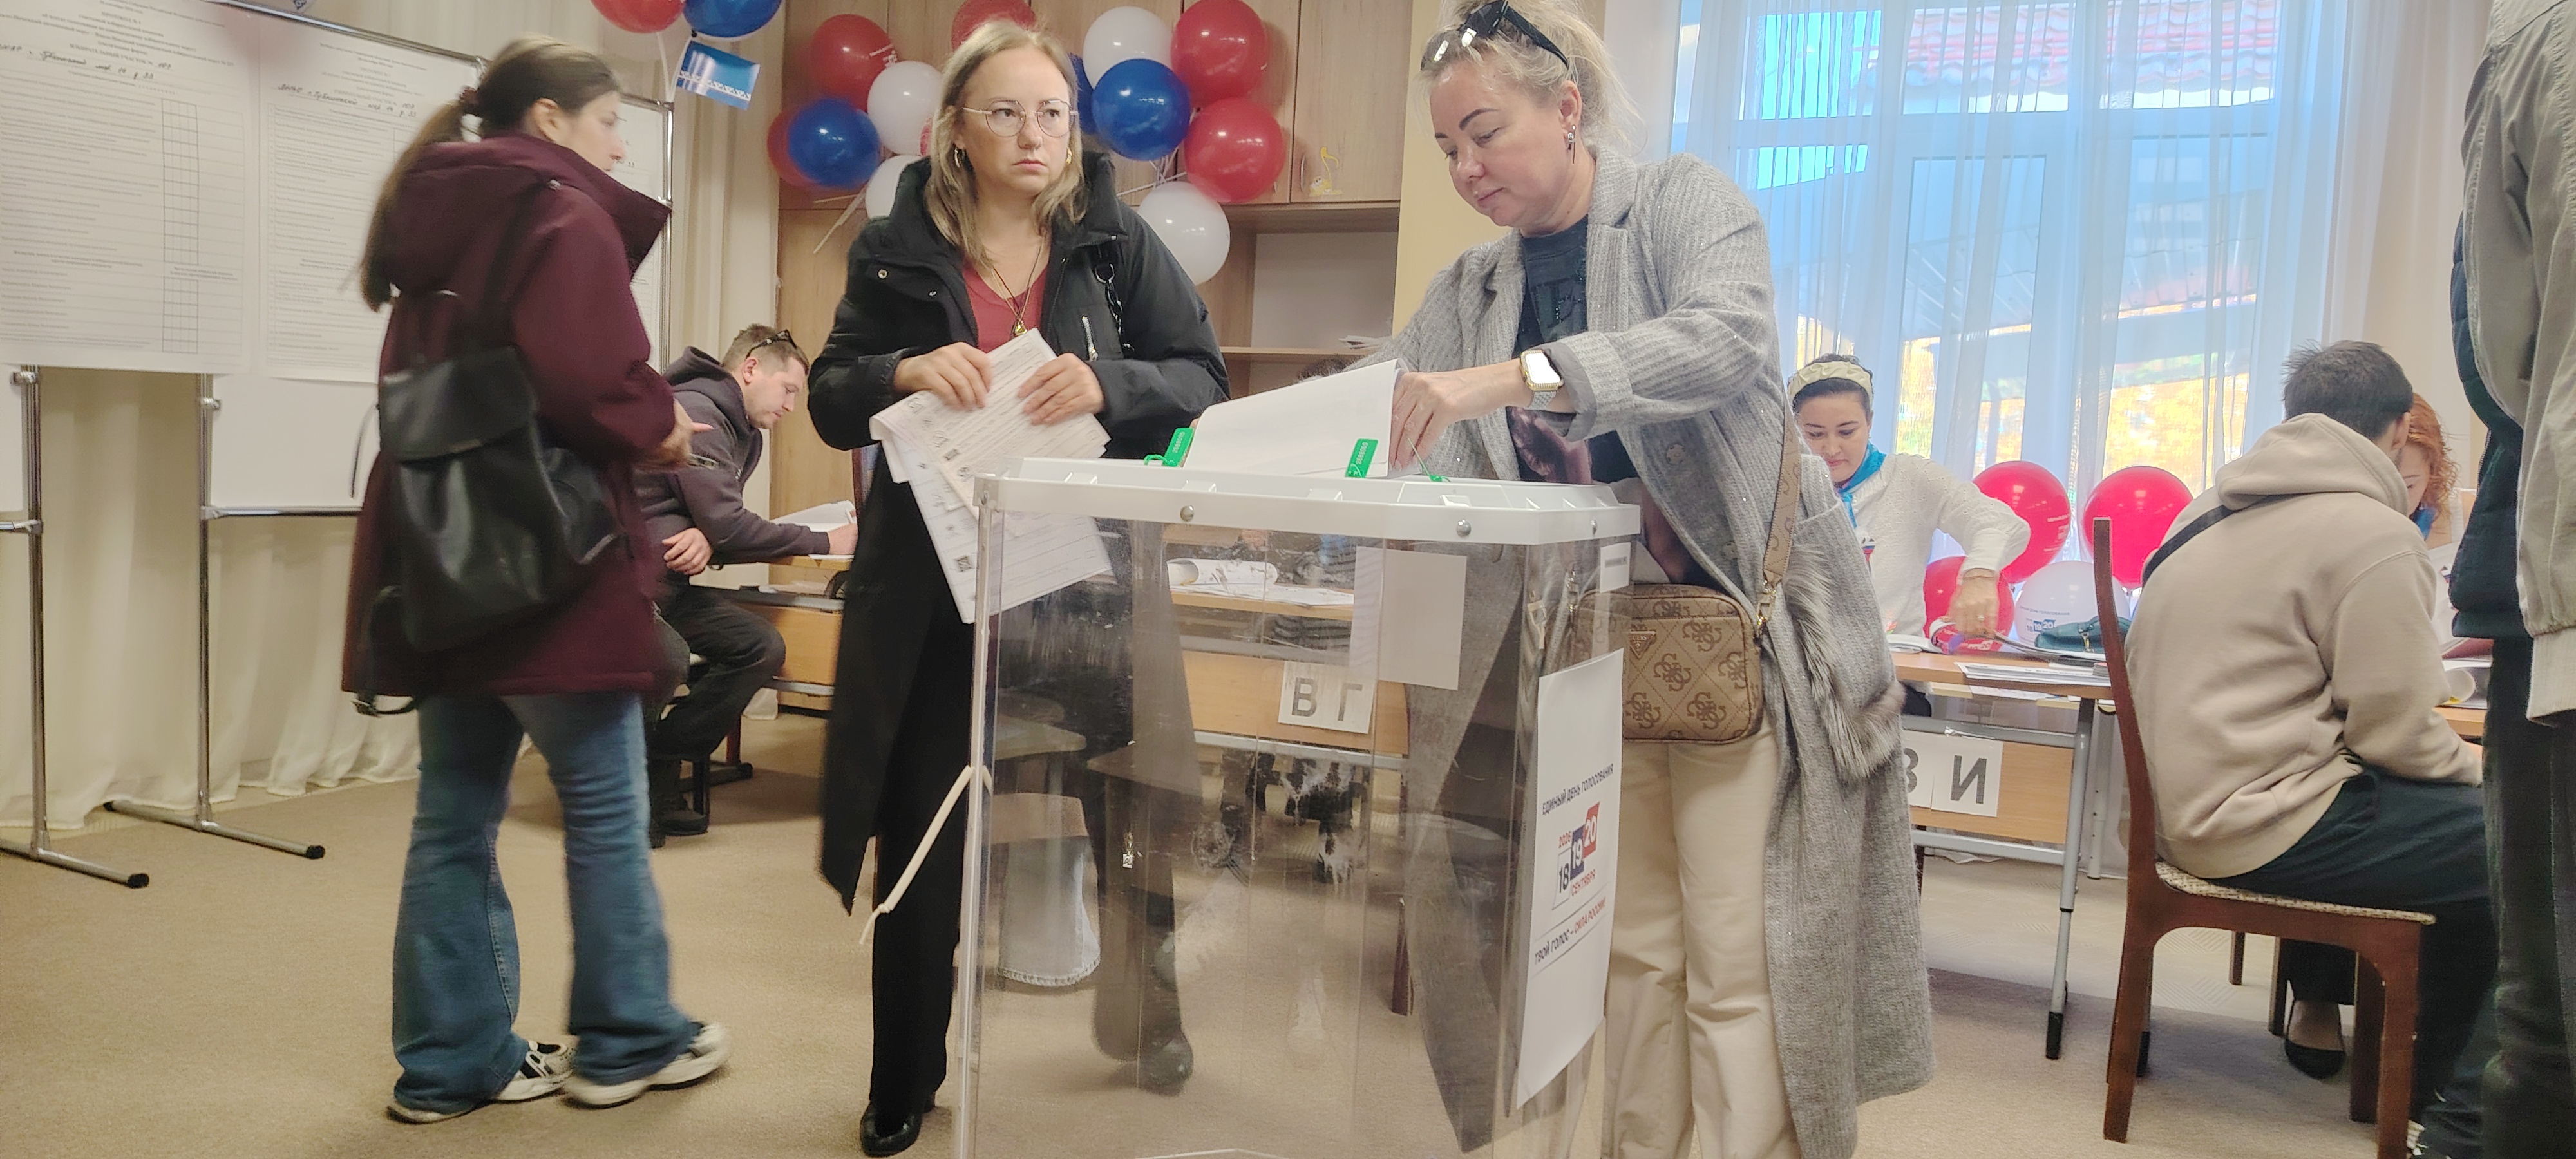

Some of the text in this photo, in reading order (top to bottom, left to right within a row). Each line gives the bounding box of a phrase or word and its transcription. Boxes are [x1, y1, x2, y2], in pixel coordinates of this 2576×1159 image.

[1291, 677, 1363, 722] В Г
[1542, 763, 1613, 816] ЕДИНЫЙ ДЕНЬ ГОЛОСОВАНИЯ
[1950, 755, 1987, 804] И
[1559, 815, 1597, 894] 18 19 20
[1571, 869, 1596, 897] СЕНТЯБРЯ
[1535, 940, 1550, 965] ТВОЙ
[1551, 928, 1569, 953] ГОЛОС
